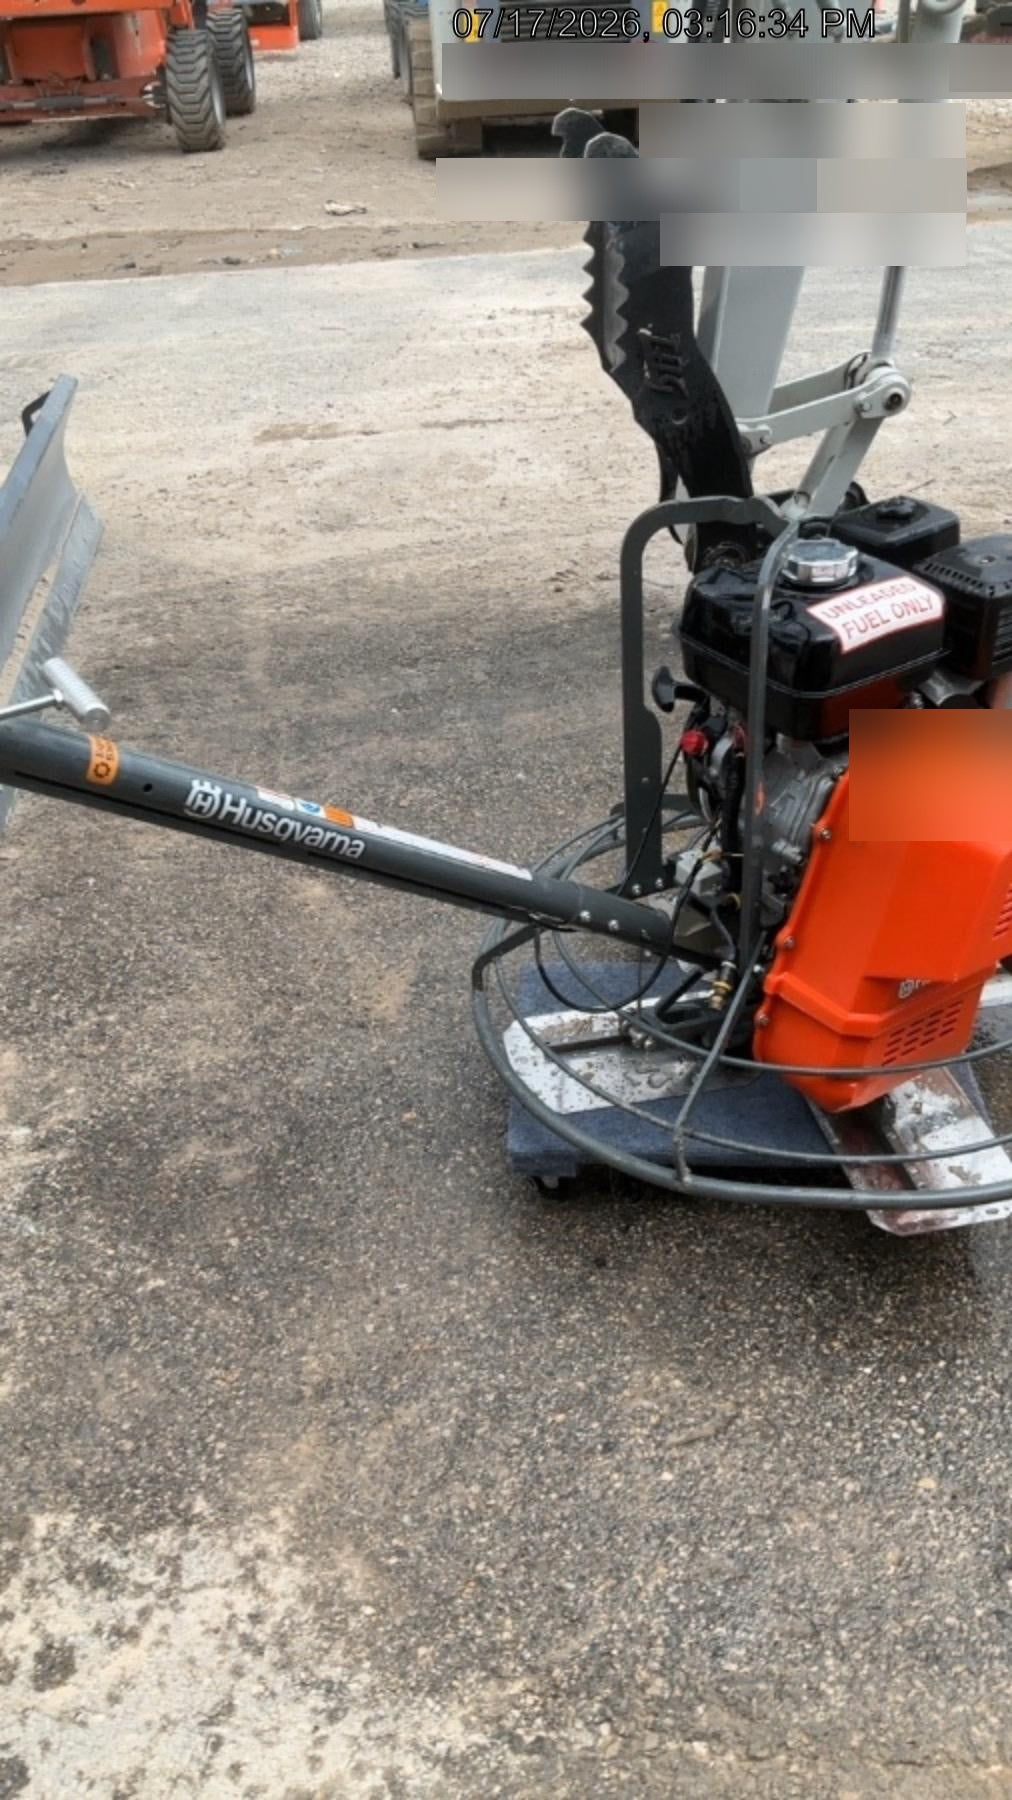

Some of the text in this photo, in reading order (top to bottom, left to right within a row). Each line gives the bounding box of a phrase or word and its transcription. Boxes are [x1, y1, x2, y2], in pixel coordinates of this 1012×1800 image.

[822, 582, 917, 619] UNLEADED
[841, 593, 934, 640] FUEL ONLY
[217, 793, 366, 860] Husqvarna
